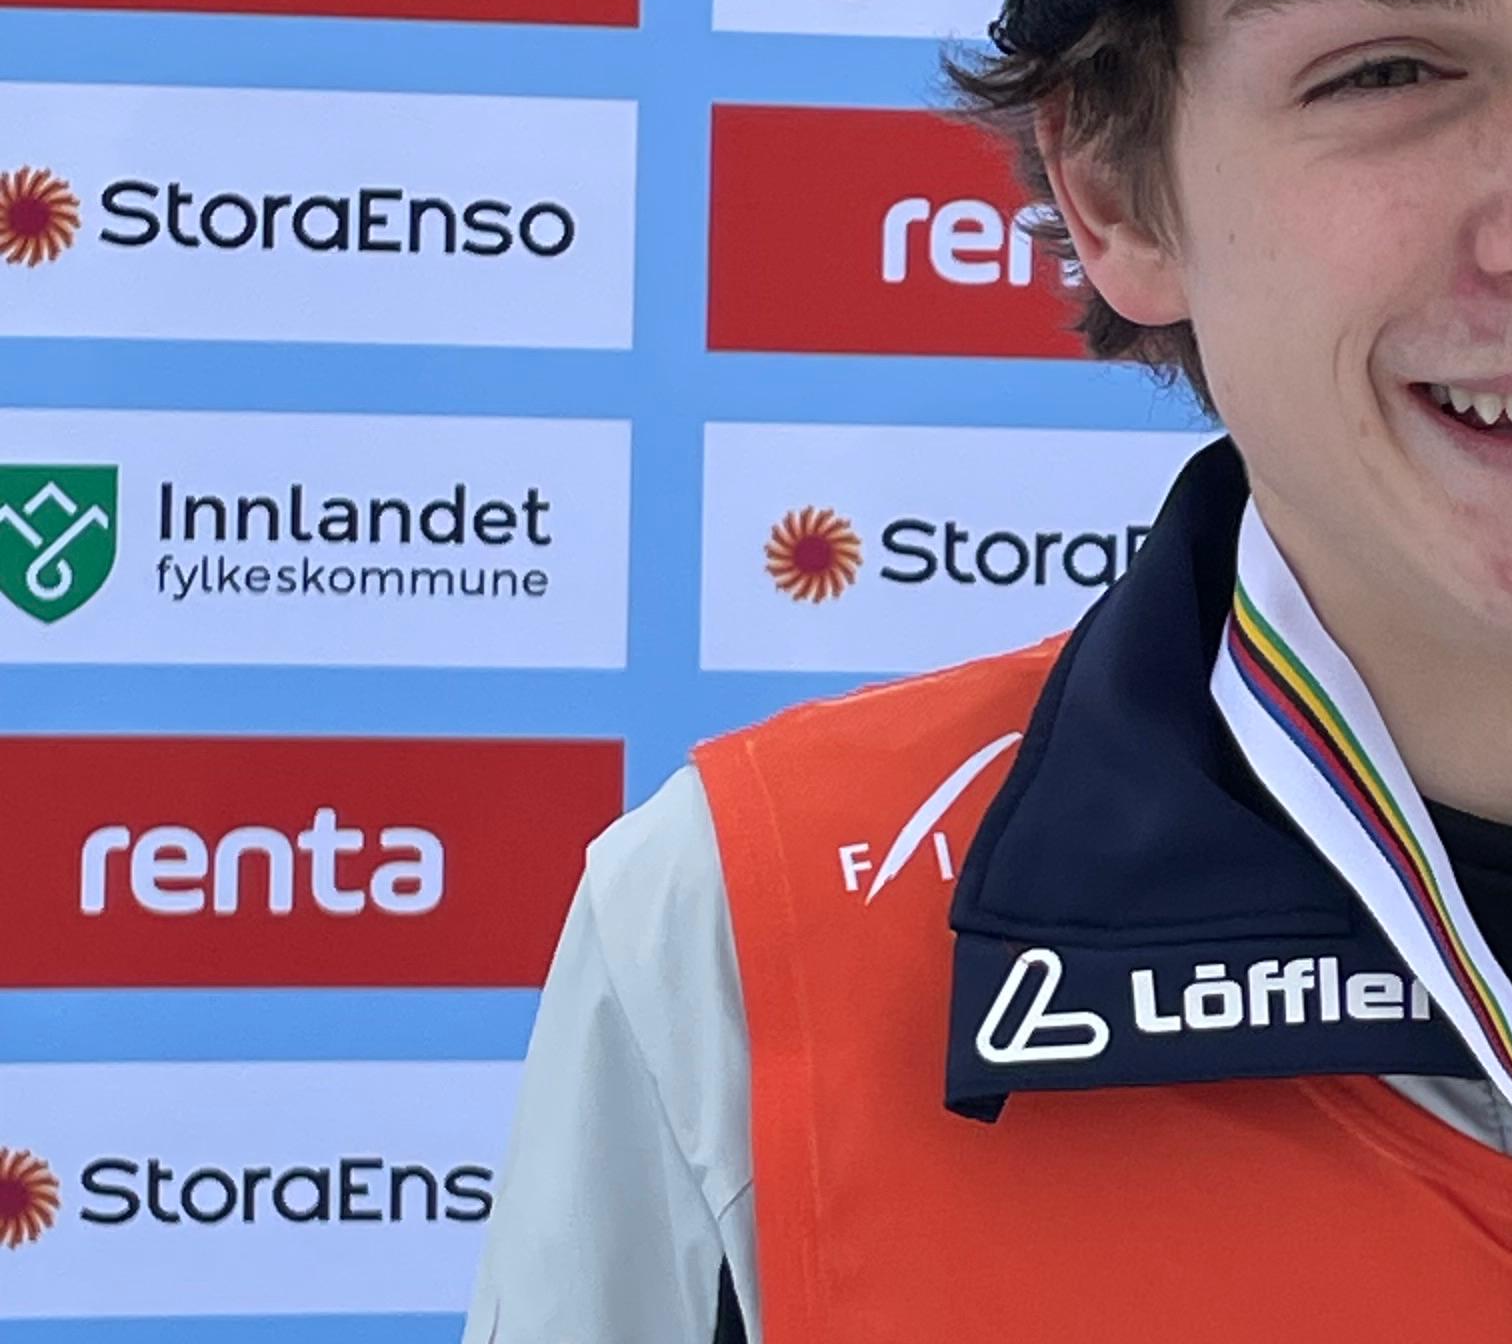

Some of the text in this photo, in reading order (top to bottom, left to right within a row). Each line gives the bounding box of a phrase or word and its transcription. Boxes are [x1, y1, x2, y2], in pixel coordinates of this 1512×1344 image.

[99, 178, 576, 258] StoraEnso
[159, 481, 553, 546] Innlandet
[156, 554, 550, 602] fylkeskommune
[79, 806, 444, 917] renta
